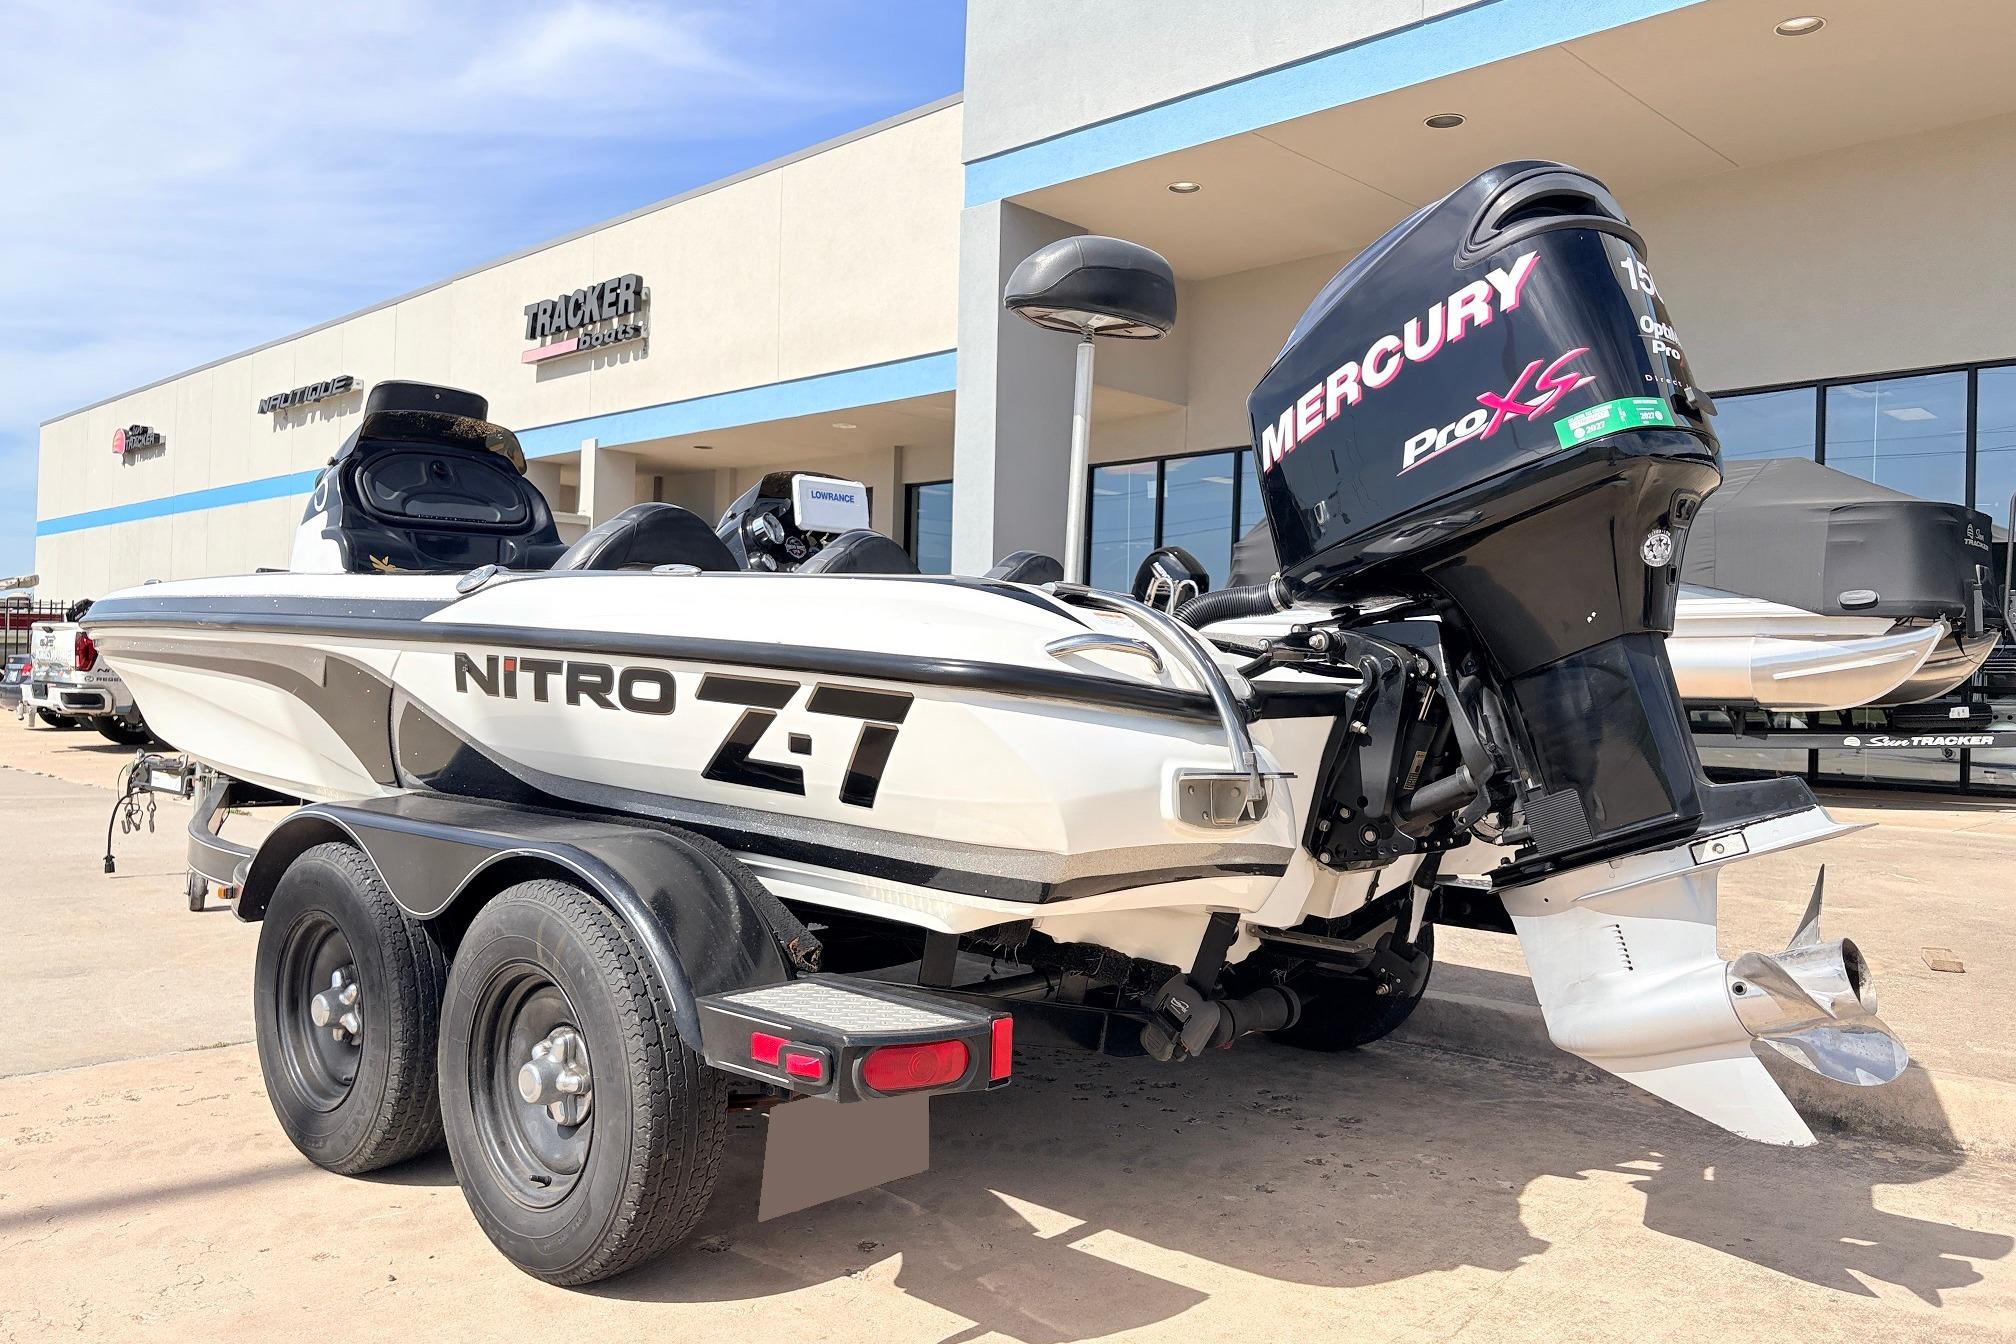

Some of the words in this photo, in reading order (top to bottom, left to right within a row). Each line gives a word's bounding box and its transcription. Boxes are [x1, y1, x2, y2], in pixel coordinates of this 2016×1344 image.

[523, 273, 641, 341] TRACKER
[578, 323, 639, 351] boats
[1261, 250, 1541, 474] MERCURY
[257, 374, 353, 415] NAUTIQUE
[810, 489, 856, 503] LOWRANCE
[453, 651, 677, 716] NITRO
[1864, 735, 1911, 748] Sun
[1910, 735, 1996, 747] TRACKER
